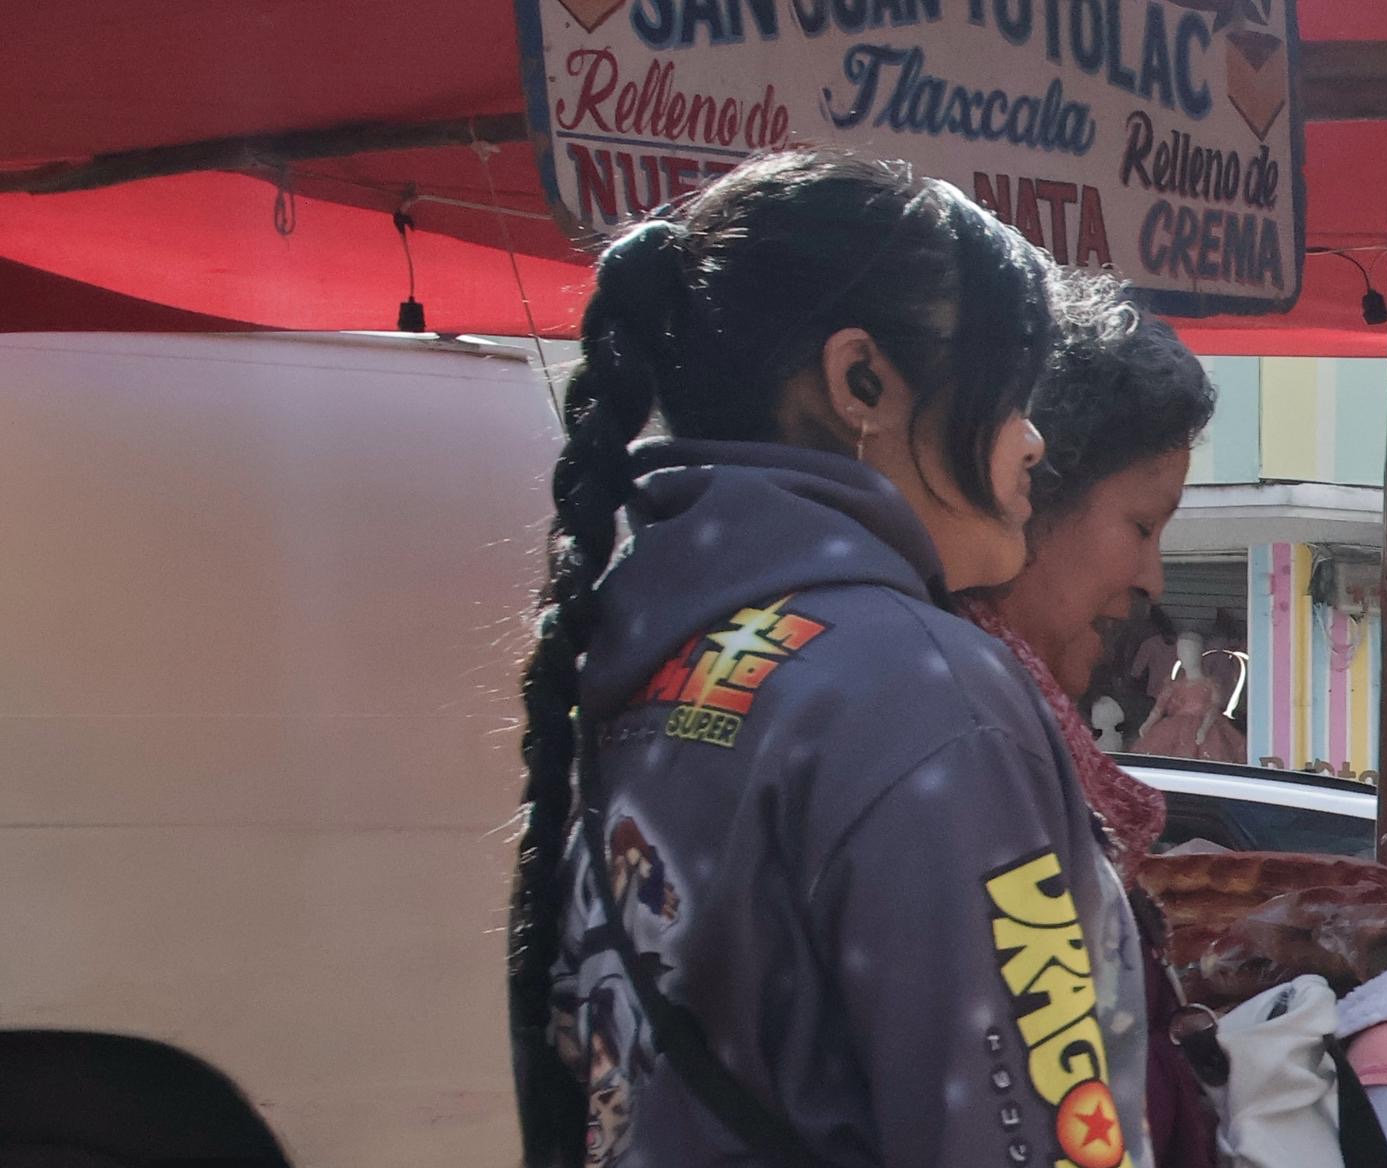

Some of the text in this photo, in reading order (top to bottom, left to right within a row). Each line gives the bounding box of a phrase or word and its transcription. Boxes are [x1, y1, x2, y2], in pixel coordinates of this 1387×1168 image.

[556, 49, 800, 151] Relleno de
[822, 43, 1097, 157] Tlaxcala
[557, 142, 742, 227] NUE
[1121, 109, 1280, 211] Relleno de
[1138, 200, 1285, 290] CREMA
[665, 704, 742, 748] SUPER
